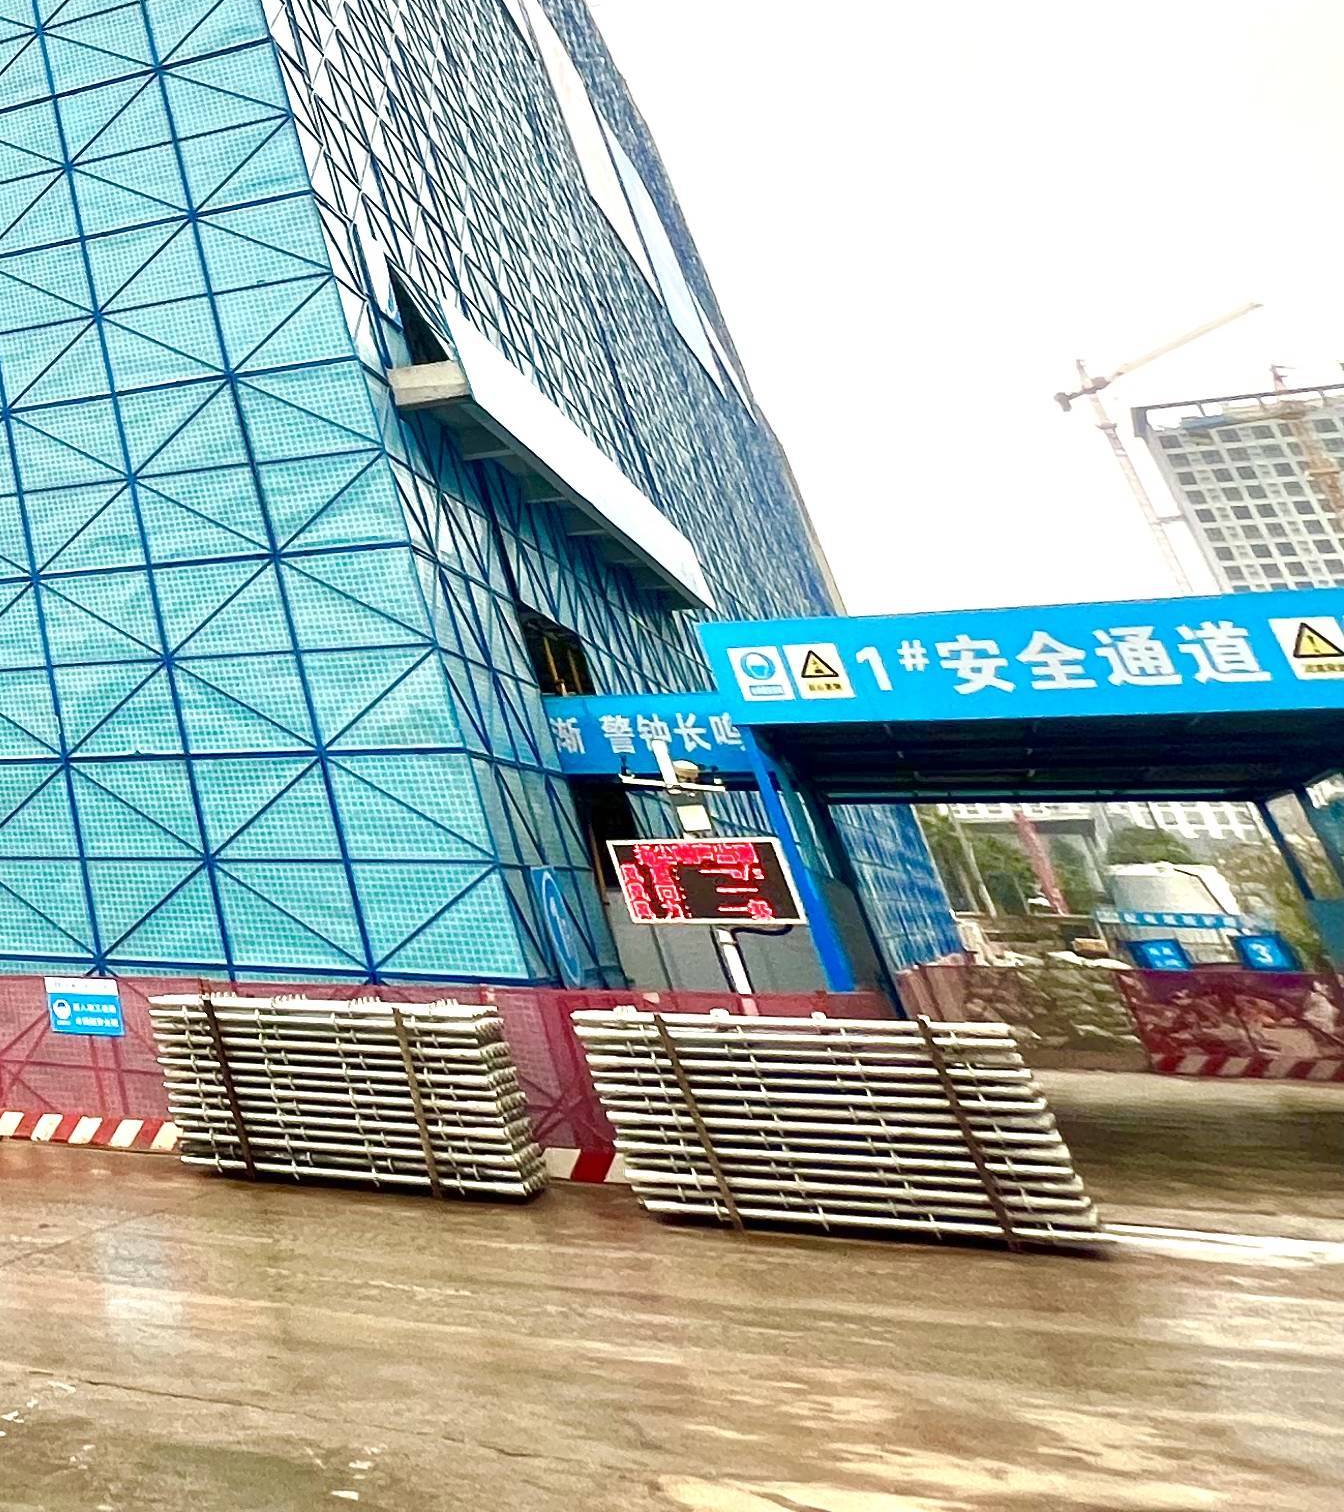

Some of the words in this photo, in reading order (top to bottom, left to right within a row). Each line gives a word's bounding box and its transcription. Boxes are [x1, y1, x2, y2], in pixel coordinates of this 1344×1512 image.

[854, 619, 1273, 697] 1#安全通道
[1248, 941, 1274, 964] 3
